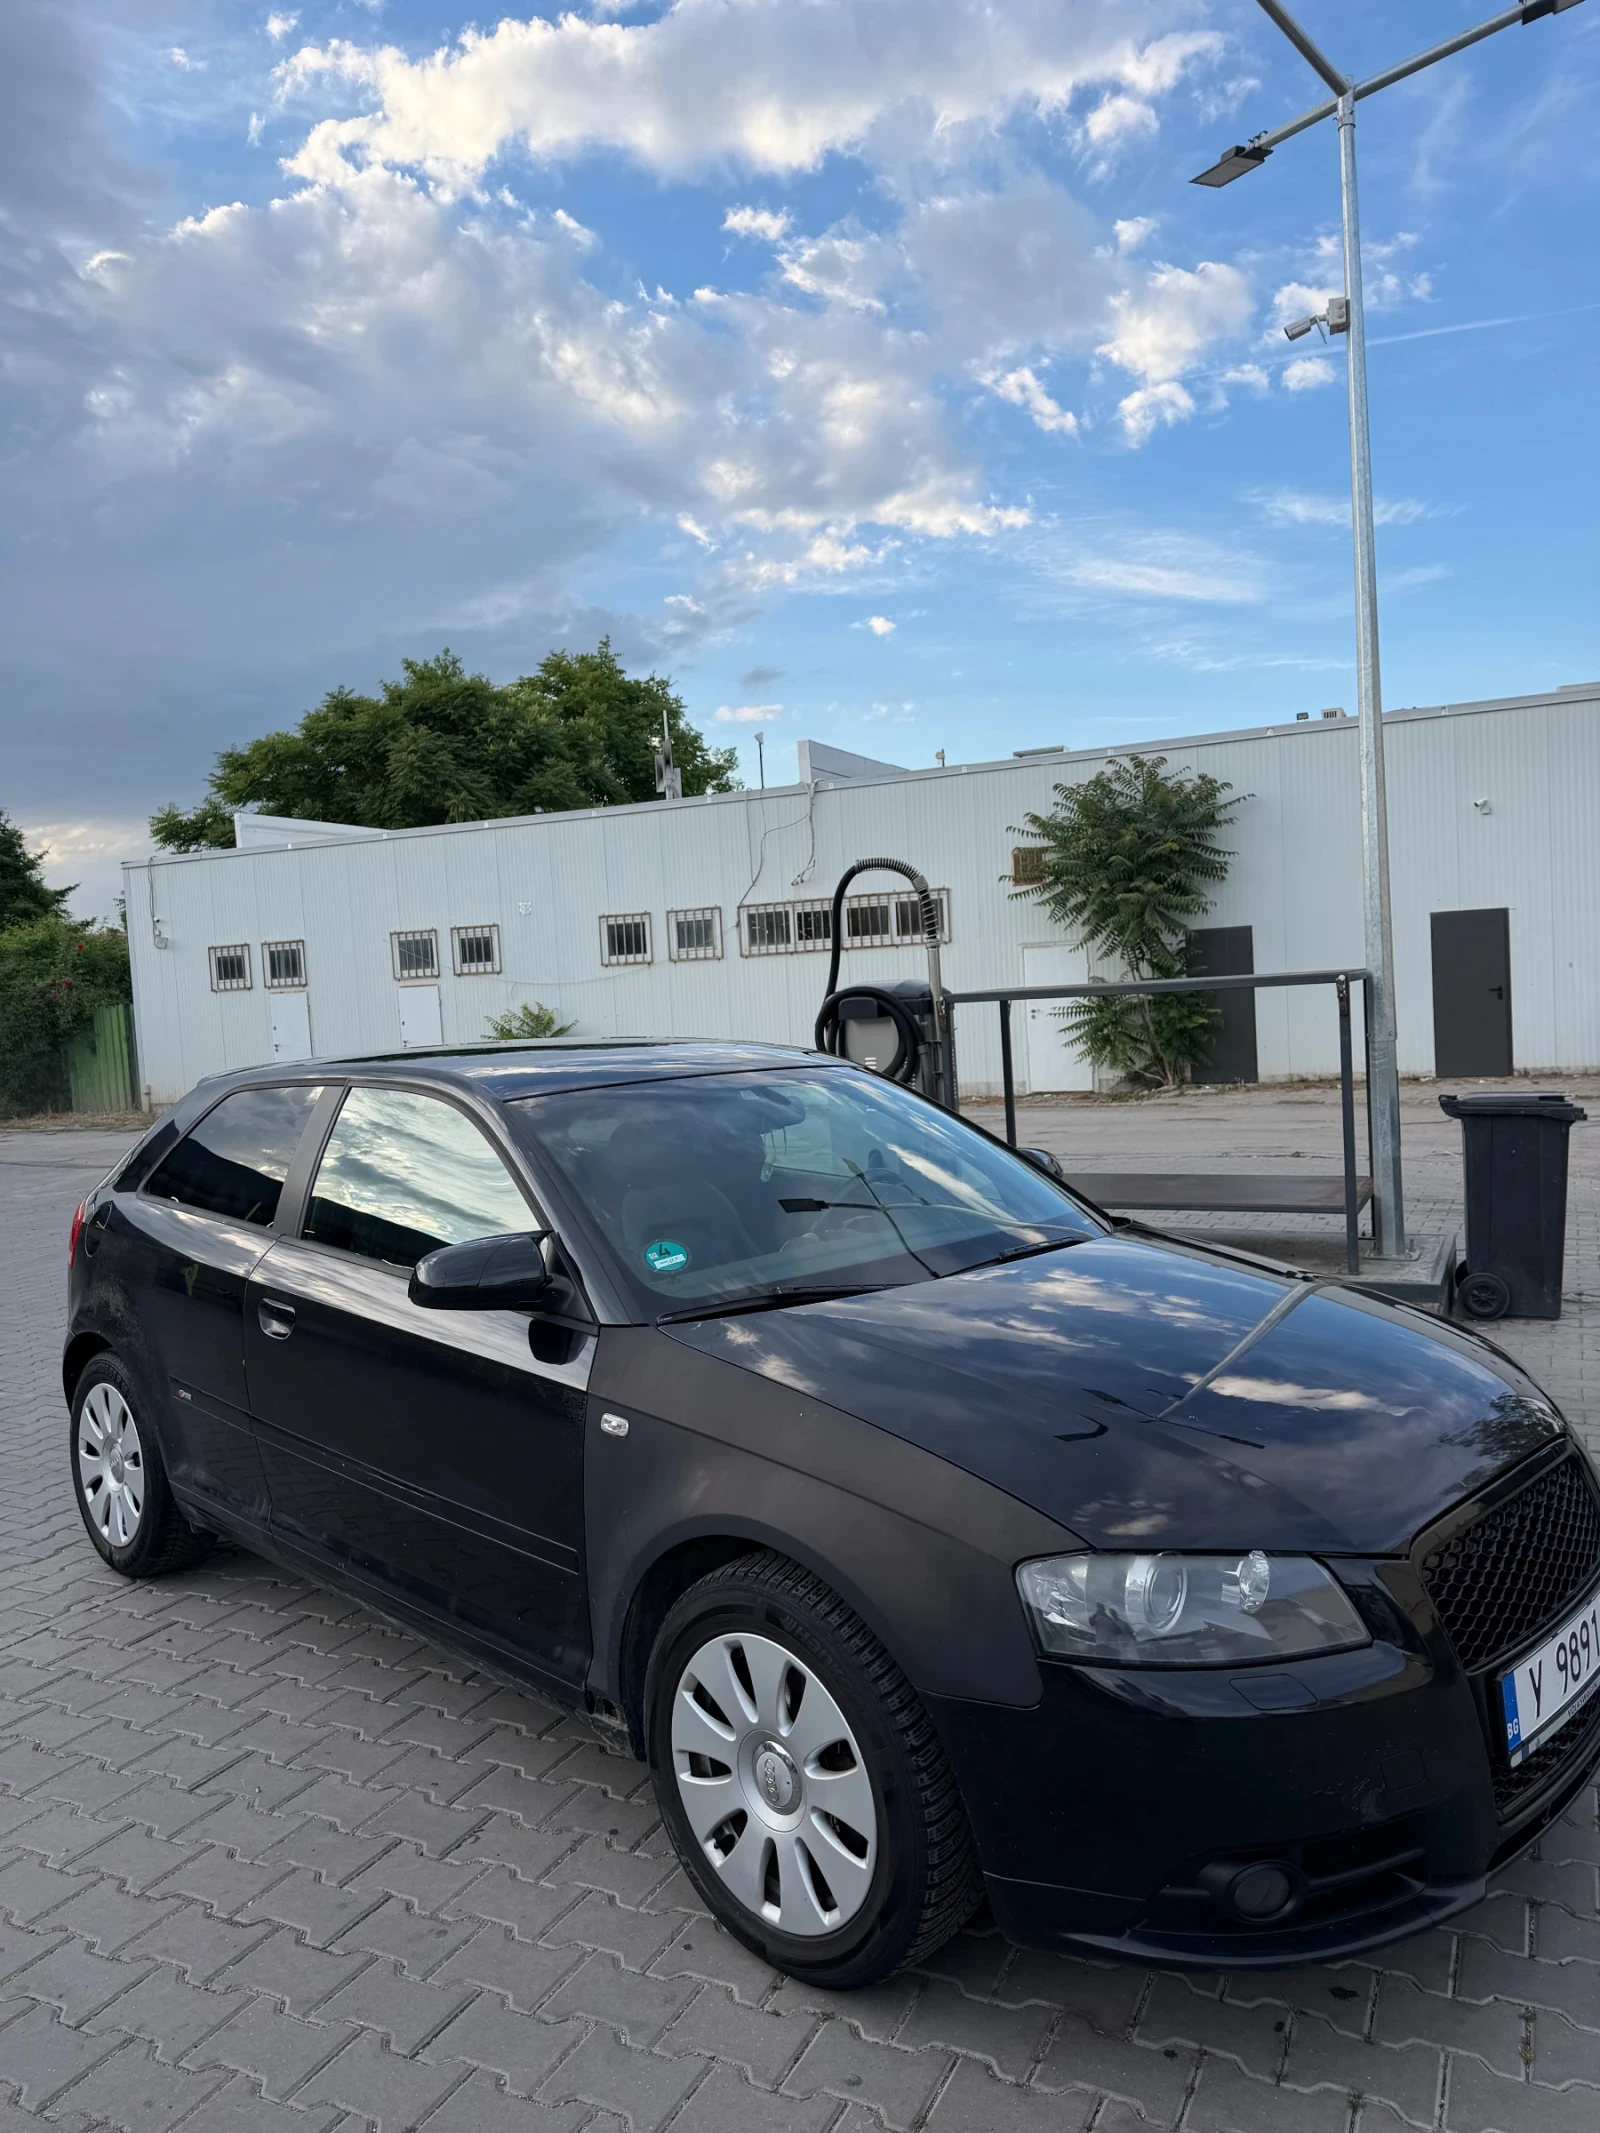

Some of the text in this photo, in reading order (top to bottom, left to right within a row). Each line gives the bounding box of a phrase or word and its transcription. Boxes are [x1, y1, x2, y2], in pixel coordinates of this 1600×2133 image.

[658, 1243, 672, 1257] 4
[792, 1624, 875, 1724] Hankoo
[1529, 1609, 1600, 1719] Y 9891
[1567, 1683, 1598, 1717] VOLKSWAGEN
[1507, 1719, 1519, 1739] BG
